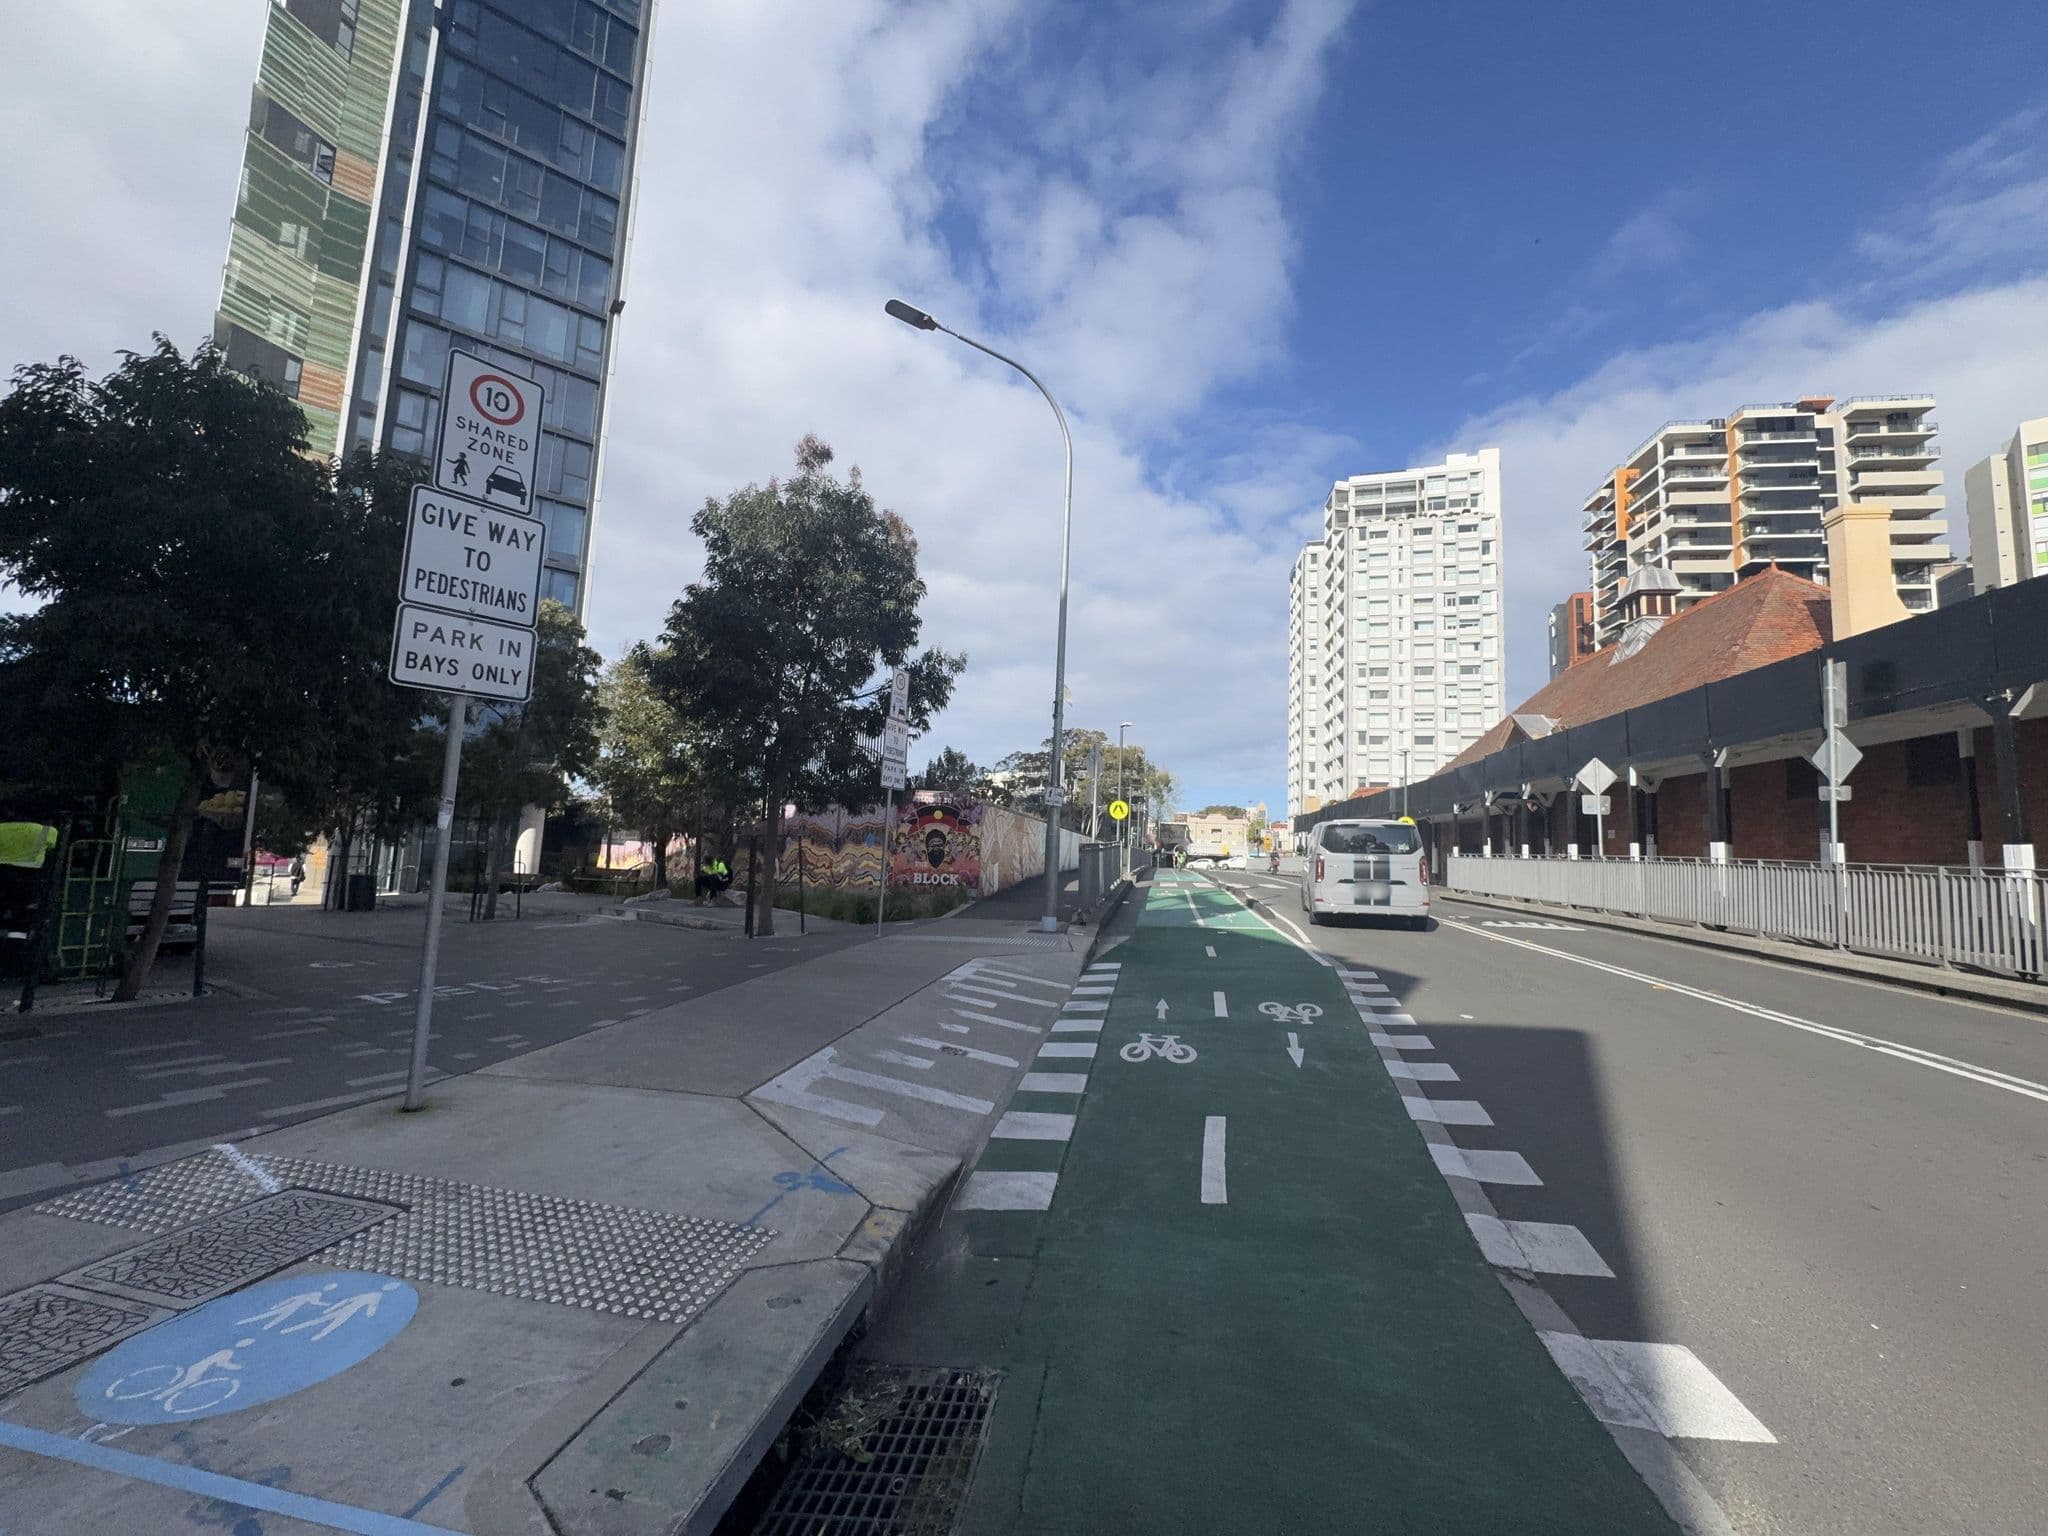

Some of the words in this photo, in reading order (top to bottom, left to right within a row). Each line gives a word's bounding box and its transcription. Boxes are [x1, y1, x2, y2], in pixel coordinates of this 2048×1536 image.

[485, 386, 511, 413] 10
[455, 415, 529, 452] SHARED
[467, 436, 515, 465] ZONE
[421, 502, 478, 537] GIVE
[488, 520, 537, 552] WAY
[463, 547, 491, 572] TO
[414, 567, 528, 613] PEDESTRIANS
[412, 622, 485, 651] PARK
[498, 638, 522, 658] IN
[404, 650, 459, 677] BAYS
[472, 662, 523, 686] ONLY
[913, 872, 960, 885] BLOCK
